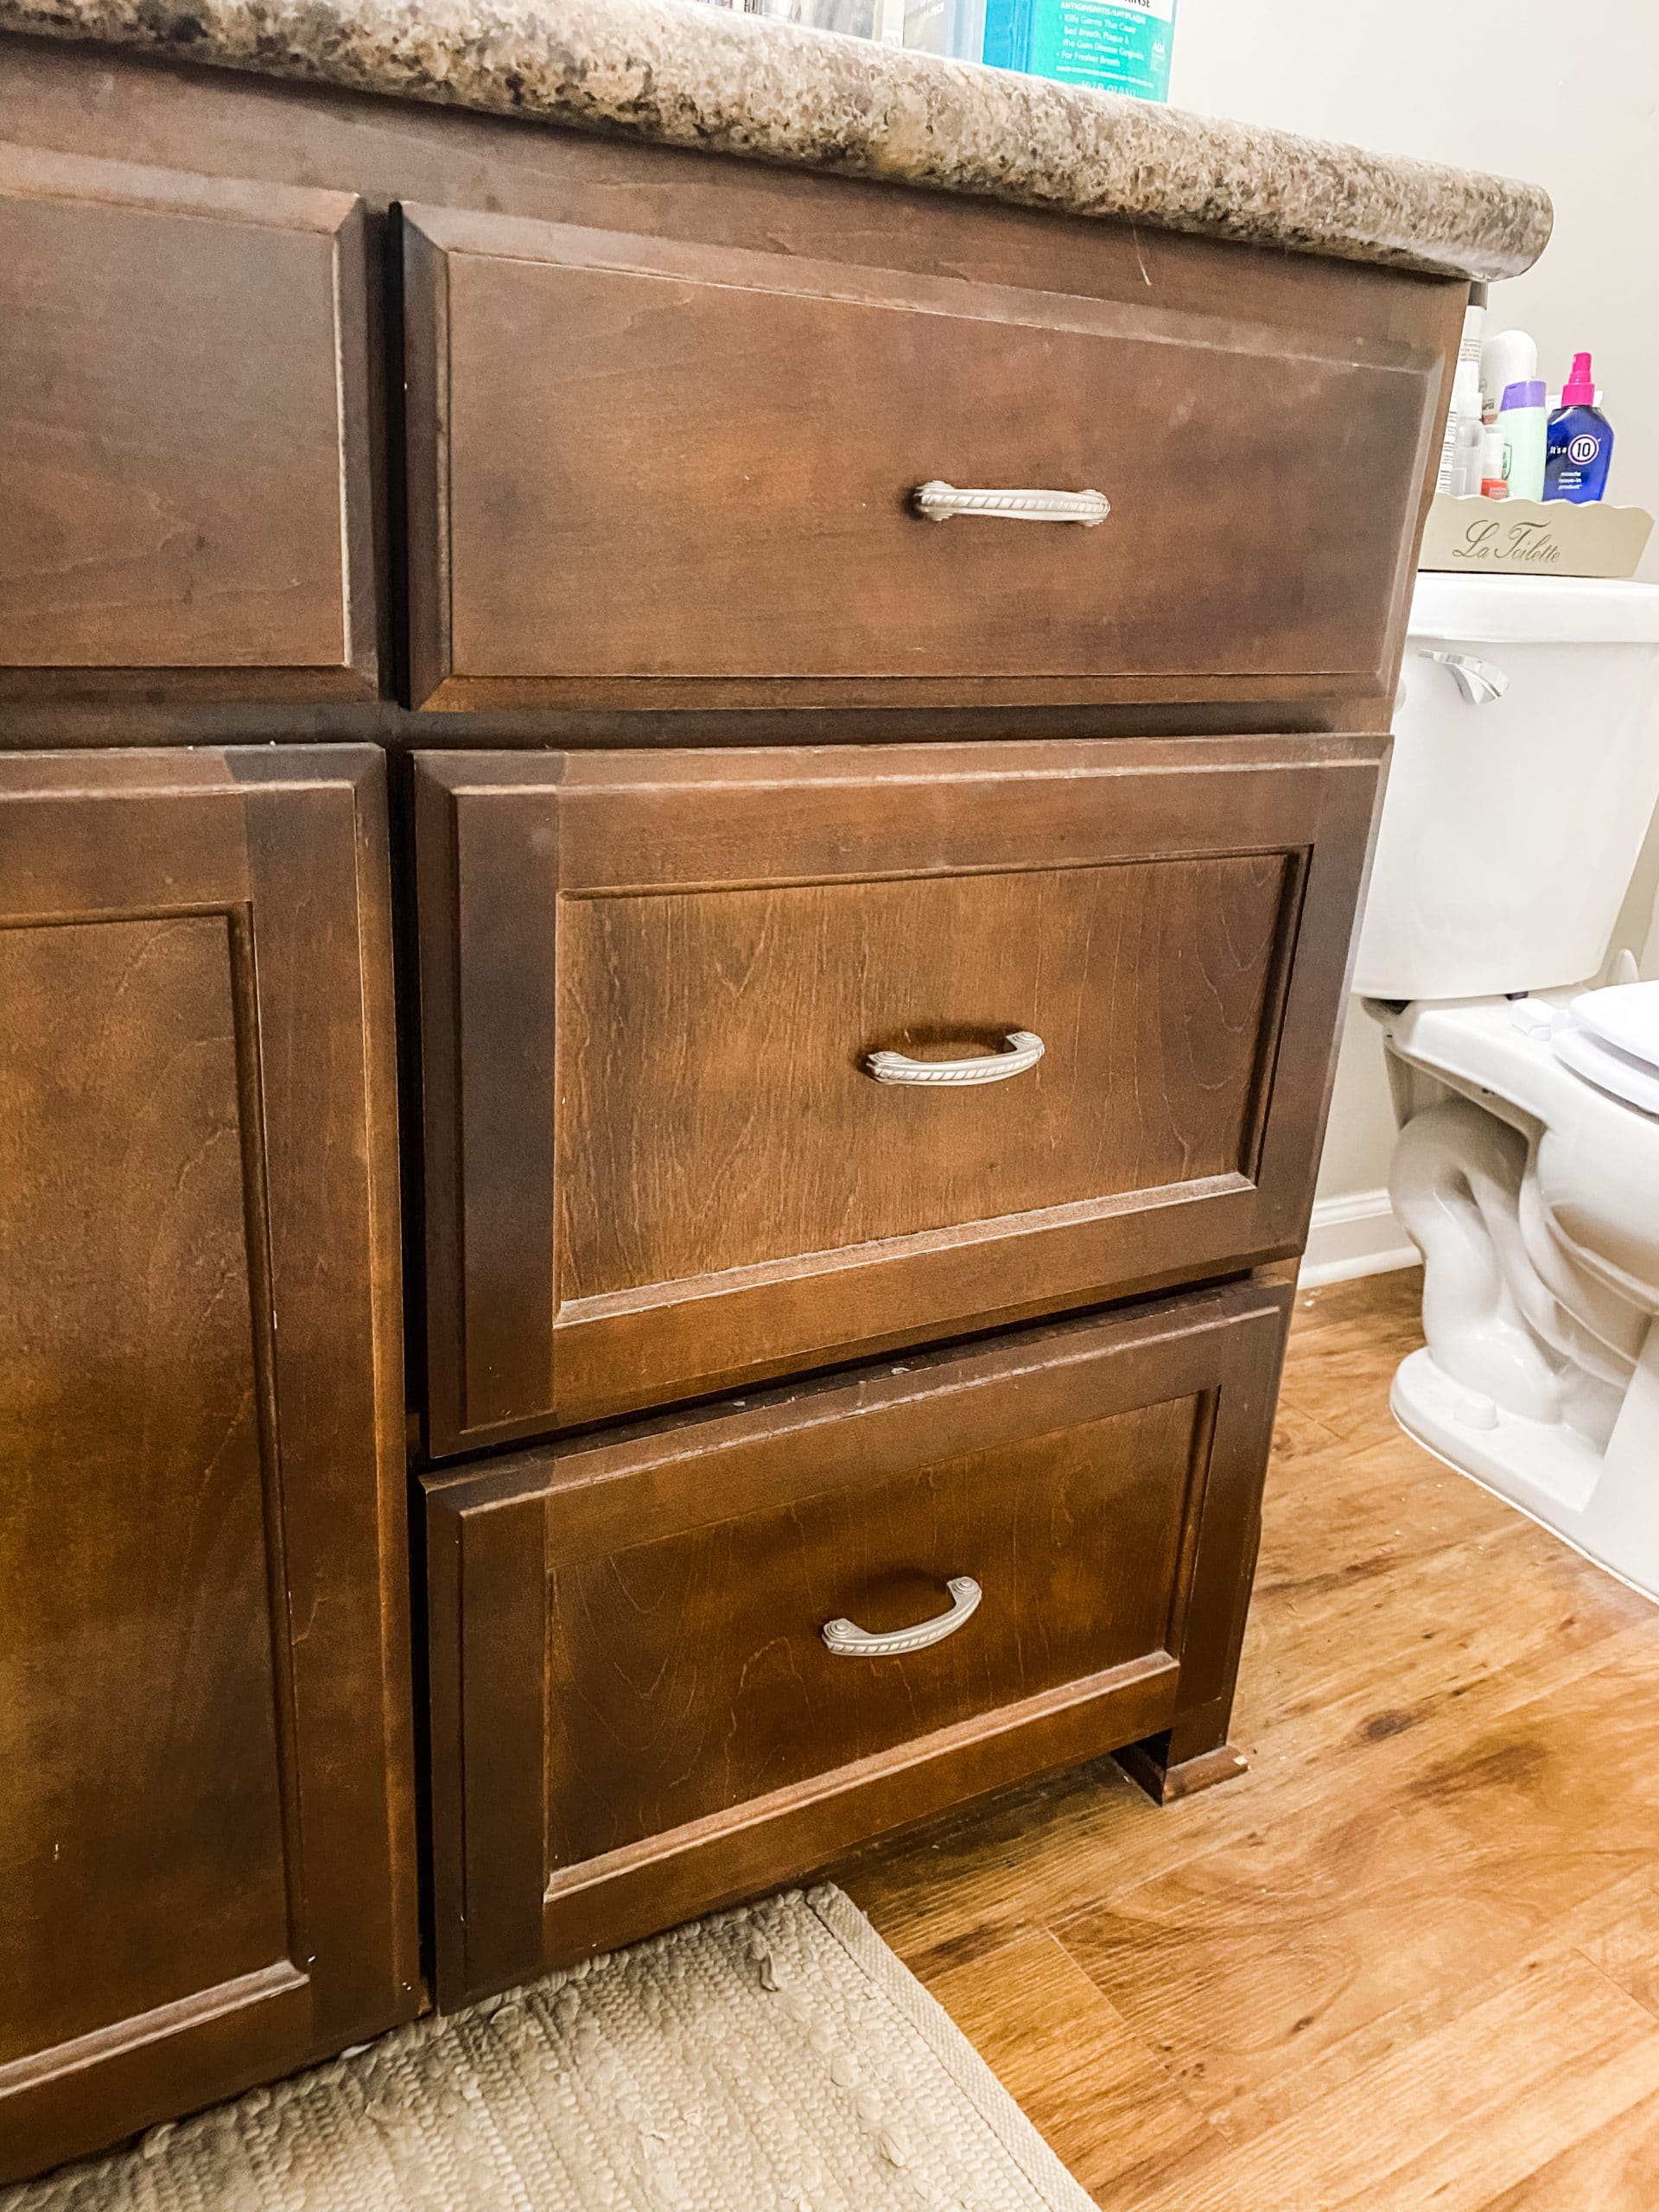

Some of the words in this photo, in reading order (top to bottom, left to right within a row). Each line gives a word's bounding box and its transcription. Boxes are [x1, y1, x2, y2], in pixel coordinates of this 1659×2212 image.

[1064, 25, 1077, 35] Bad
[1063, 38, 1076, 48] the
[1077, 39, 1093, 49] Gum
[1061, 49, 1072, 60] For
[1577, 442, 1591, 457] 10
[1452, 519, 1500, 558] La
[1494, 521, 1560, 563] Toilette
